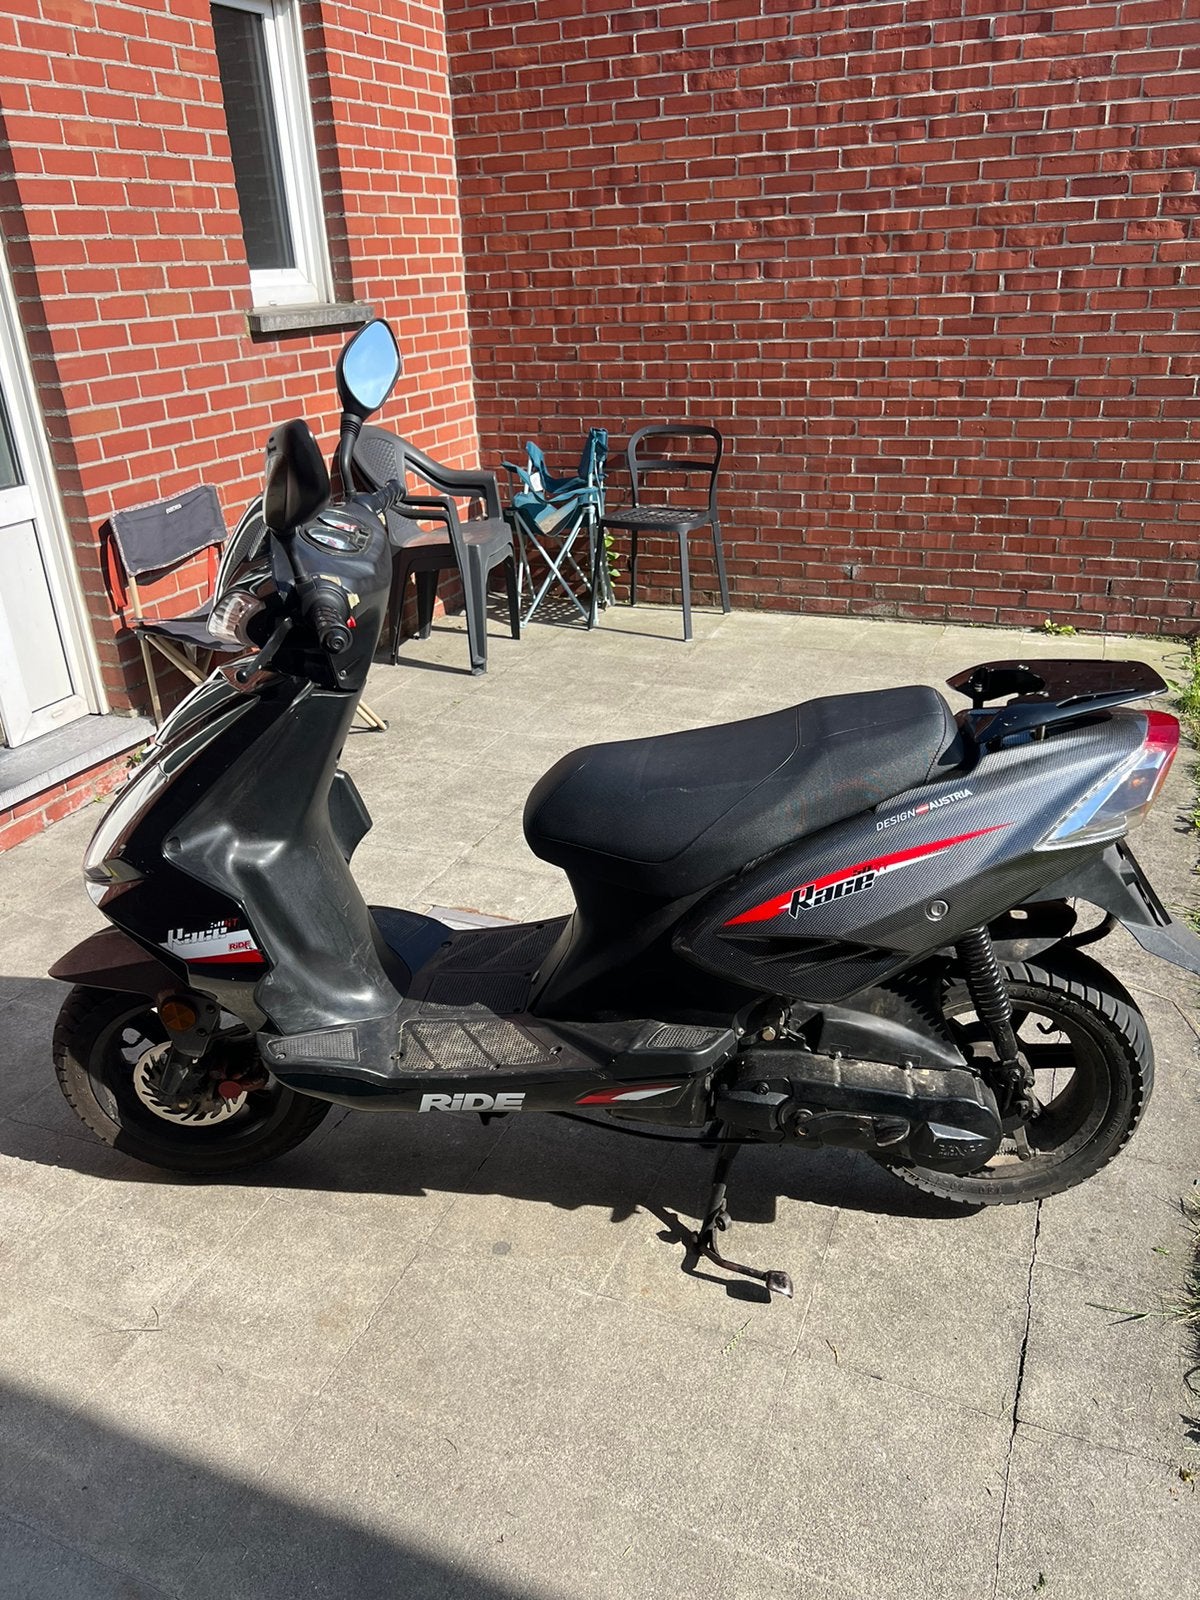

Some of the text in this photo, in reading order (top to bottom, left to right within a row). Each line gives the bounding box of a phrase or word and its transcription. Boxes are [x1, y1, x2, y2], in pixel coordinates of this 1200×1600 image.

[876, 788, 973, 832] DESIGN AUSTRIA
[788, 871, 877, 920] Race
[418, 1092, 526, 1114] RiDE
